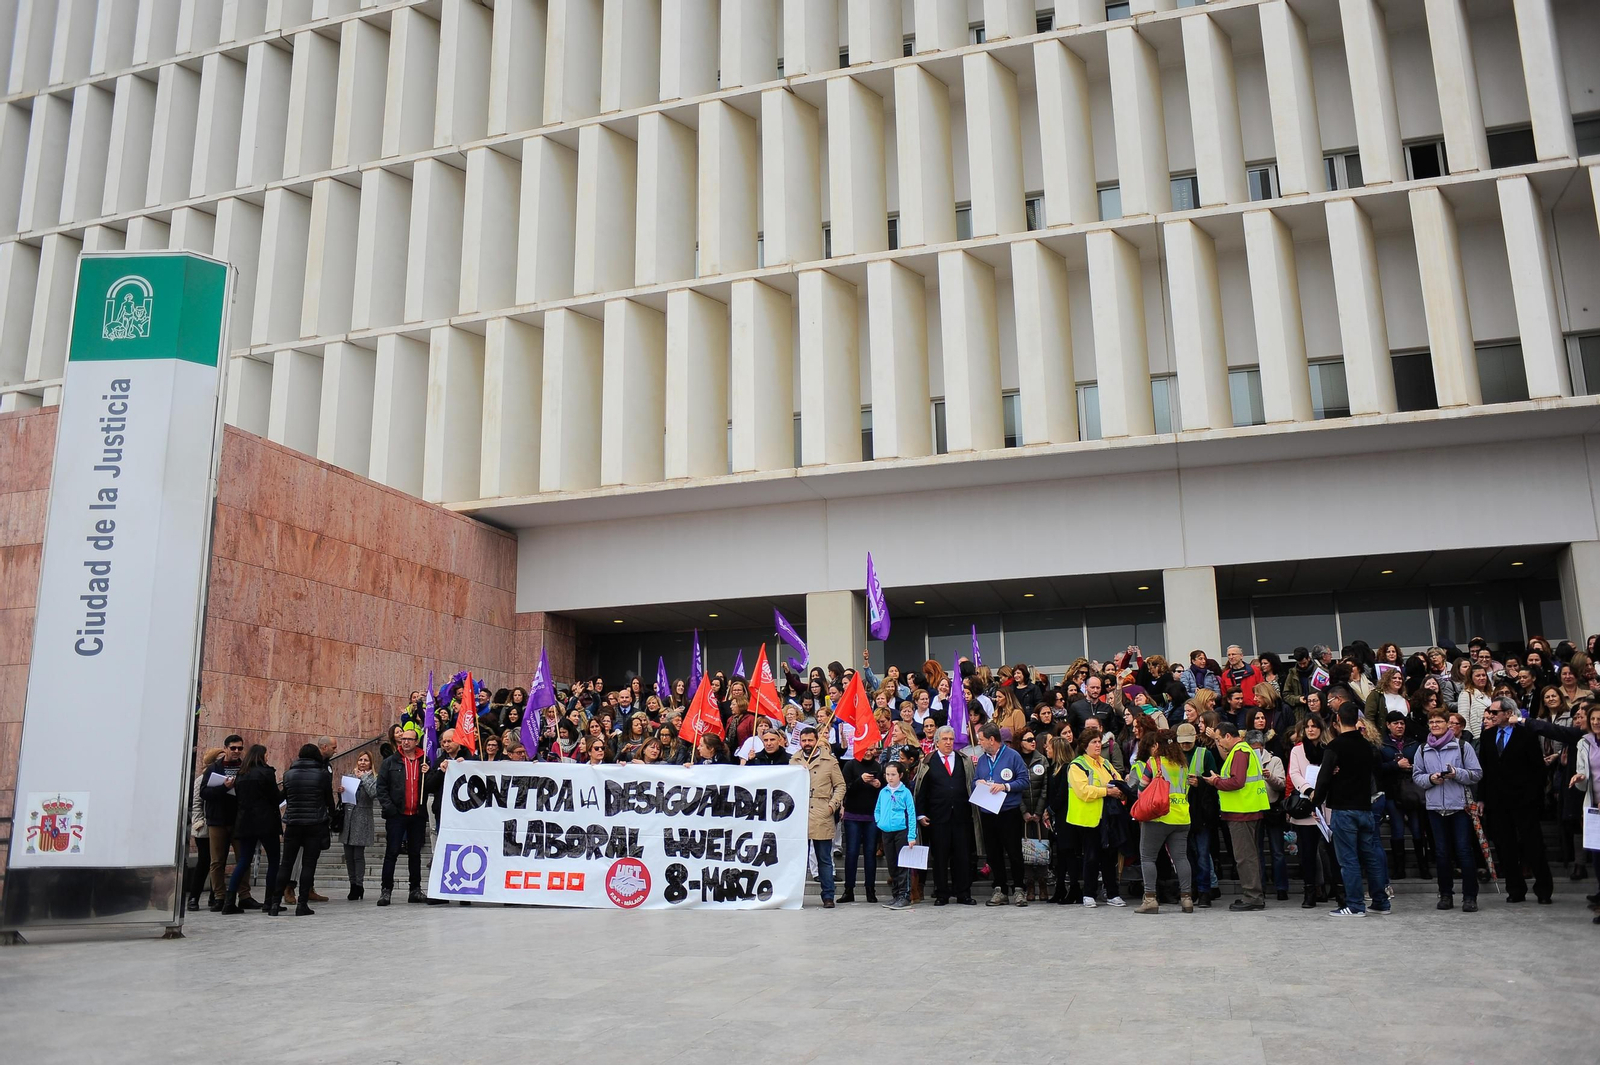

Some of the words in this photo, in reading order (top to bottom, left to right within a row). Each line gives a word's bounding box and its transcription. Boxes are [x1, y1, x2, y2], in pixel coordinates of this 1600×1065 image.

[93, 378, 131, 479] Justicia
[88, 487, 119, 510] la
[86, 519, 116, 551] de
[74, 560, 112, 657] Ciudad
[451, 774, 575, 812] CONTRA
[579, 786, 600, 811] LA
[502, 818, 645, 860] LABORAL
[663, 827, 779, 867] HUELGA
[615, 864, 642, 879] UGT
